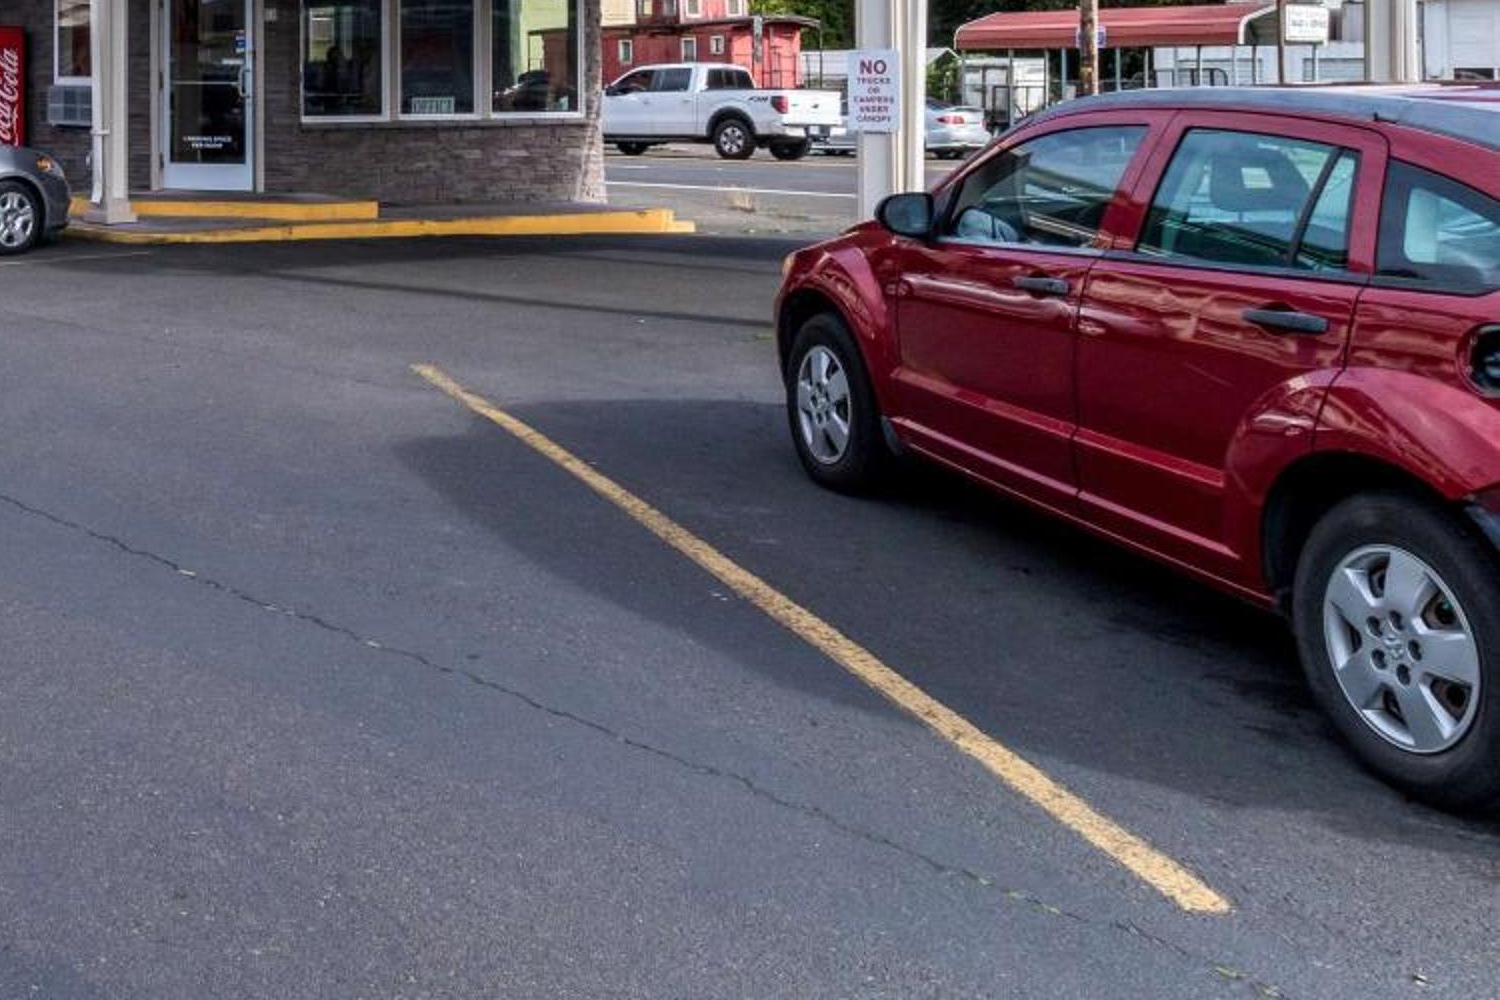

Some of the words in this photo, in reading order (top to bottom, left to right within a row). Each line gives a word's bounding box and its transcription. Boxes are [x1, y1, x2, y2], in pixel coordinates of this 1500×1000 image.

[860, 59, 887, 75] NO
[857, 77, 891, 85] TRUCKS
[853, 96, 894, 104] CAMPERS
[855, 115, 891, 123] CANOPY
